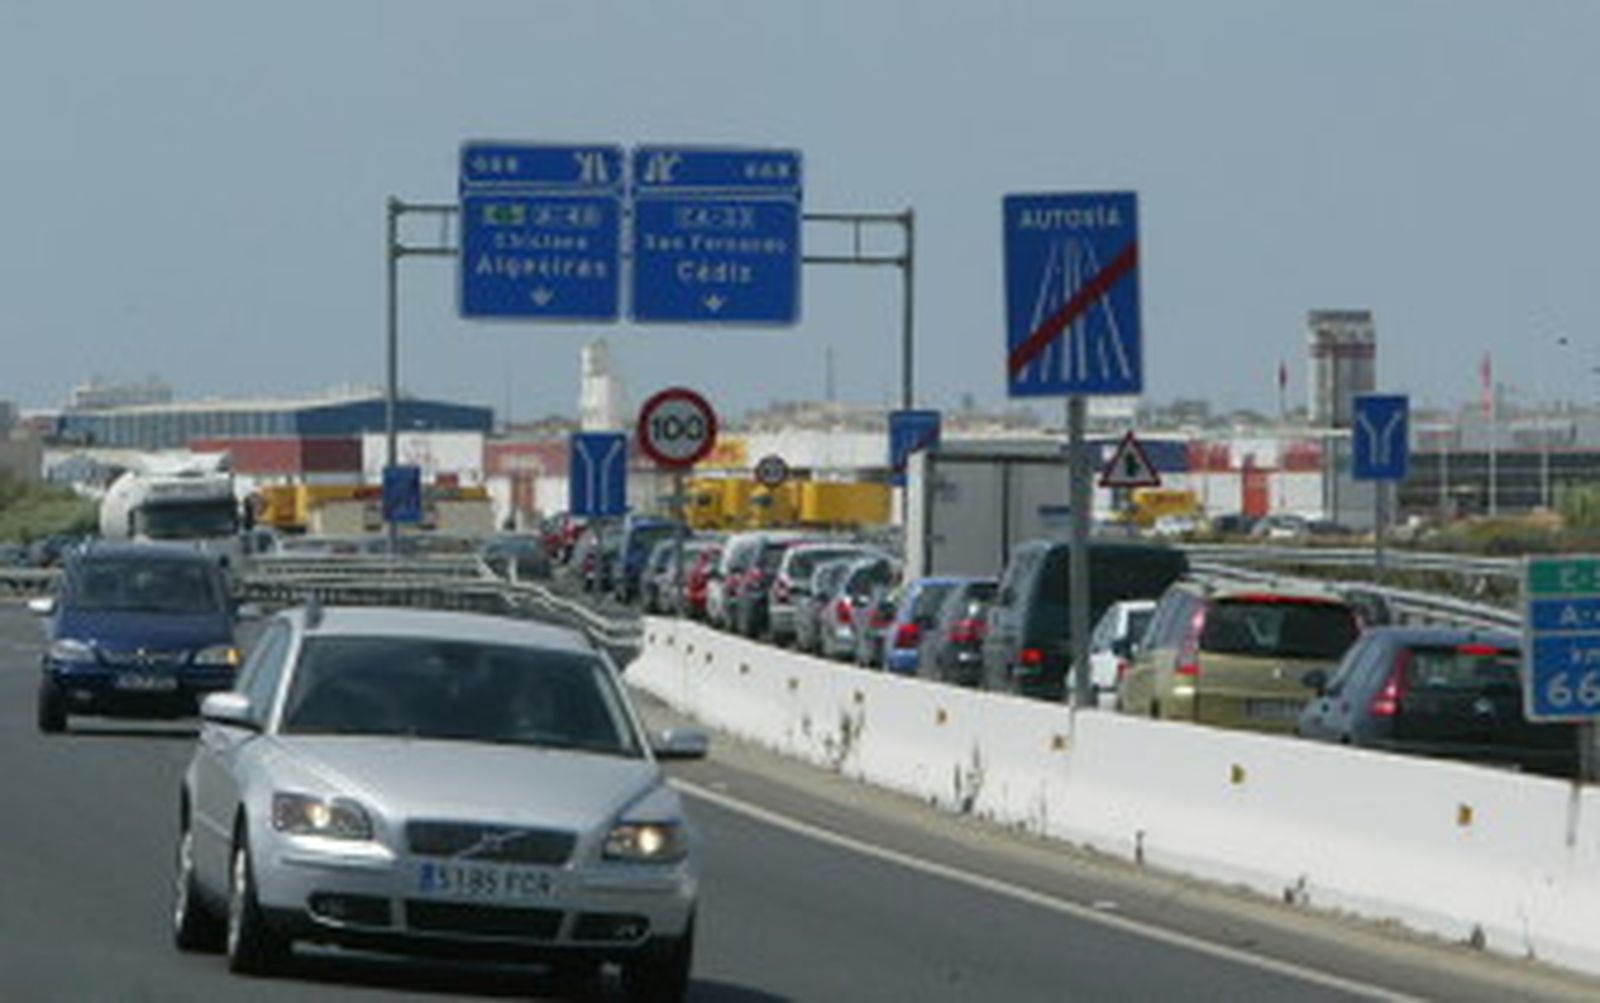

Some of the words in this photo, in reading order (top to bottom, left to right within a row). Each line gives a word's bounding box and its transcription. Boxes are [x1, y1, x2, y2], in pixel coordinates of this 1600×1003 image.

[1019, 204, 1122, 230] AUTOVÍA
[643, 233, 684, 250] San
[475, 252, 607, 281] Algeciras
[677, 257, 752, 284] Cádiz
[652, 414, 702, 442] 100
